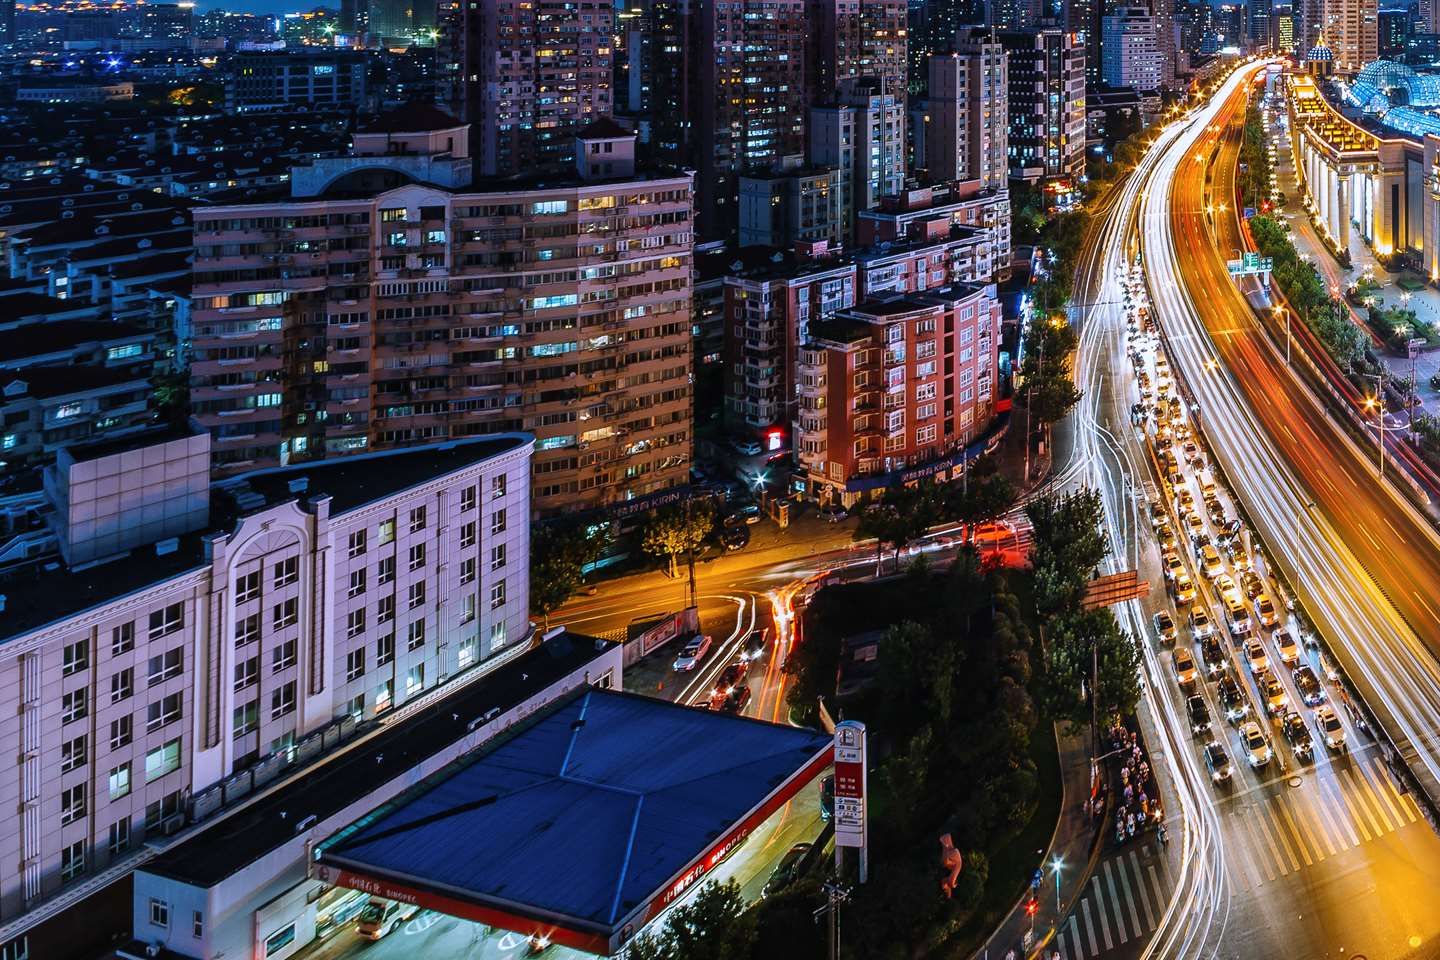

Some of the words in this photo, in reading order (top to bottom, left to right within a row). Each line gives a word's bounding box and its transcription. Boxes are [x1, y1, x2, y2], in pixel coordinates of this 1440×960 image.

[651, 492, 680, 508] KIRIN
[664, 864, 705, 903] 中国石化
[711, 829, 748, 864] SINOPEC
[386, 888, 418, 903] SINOPEC
